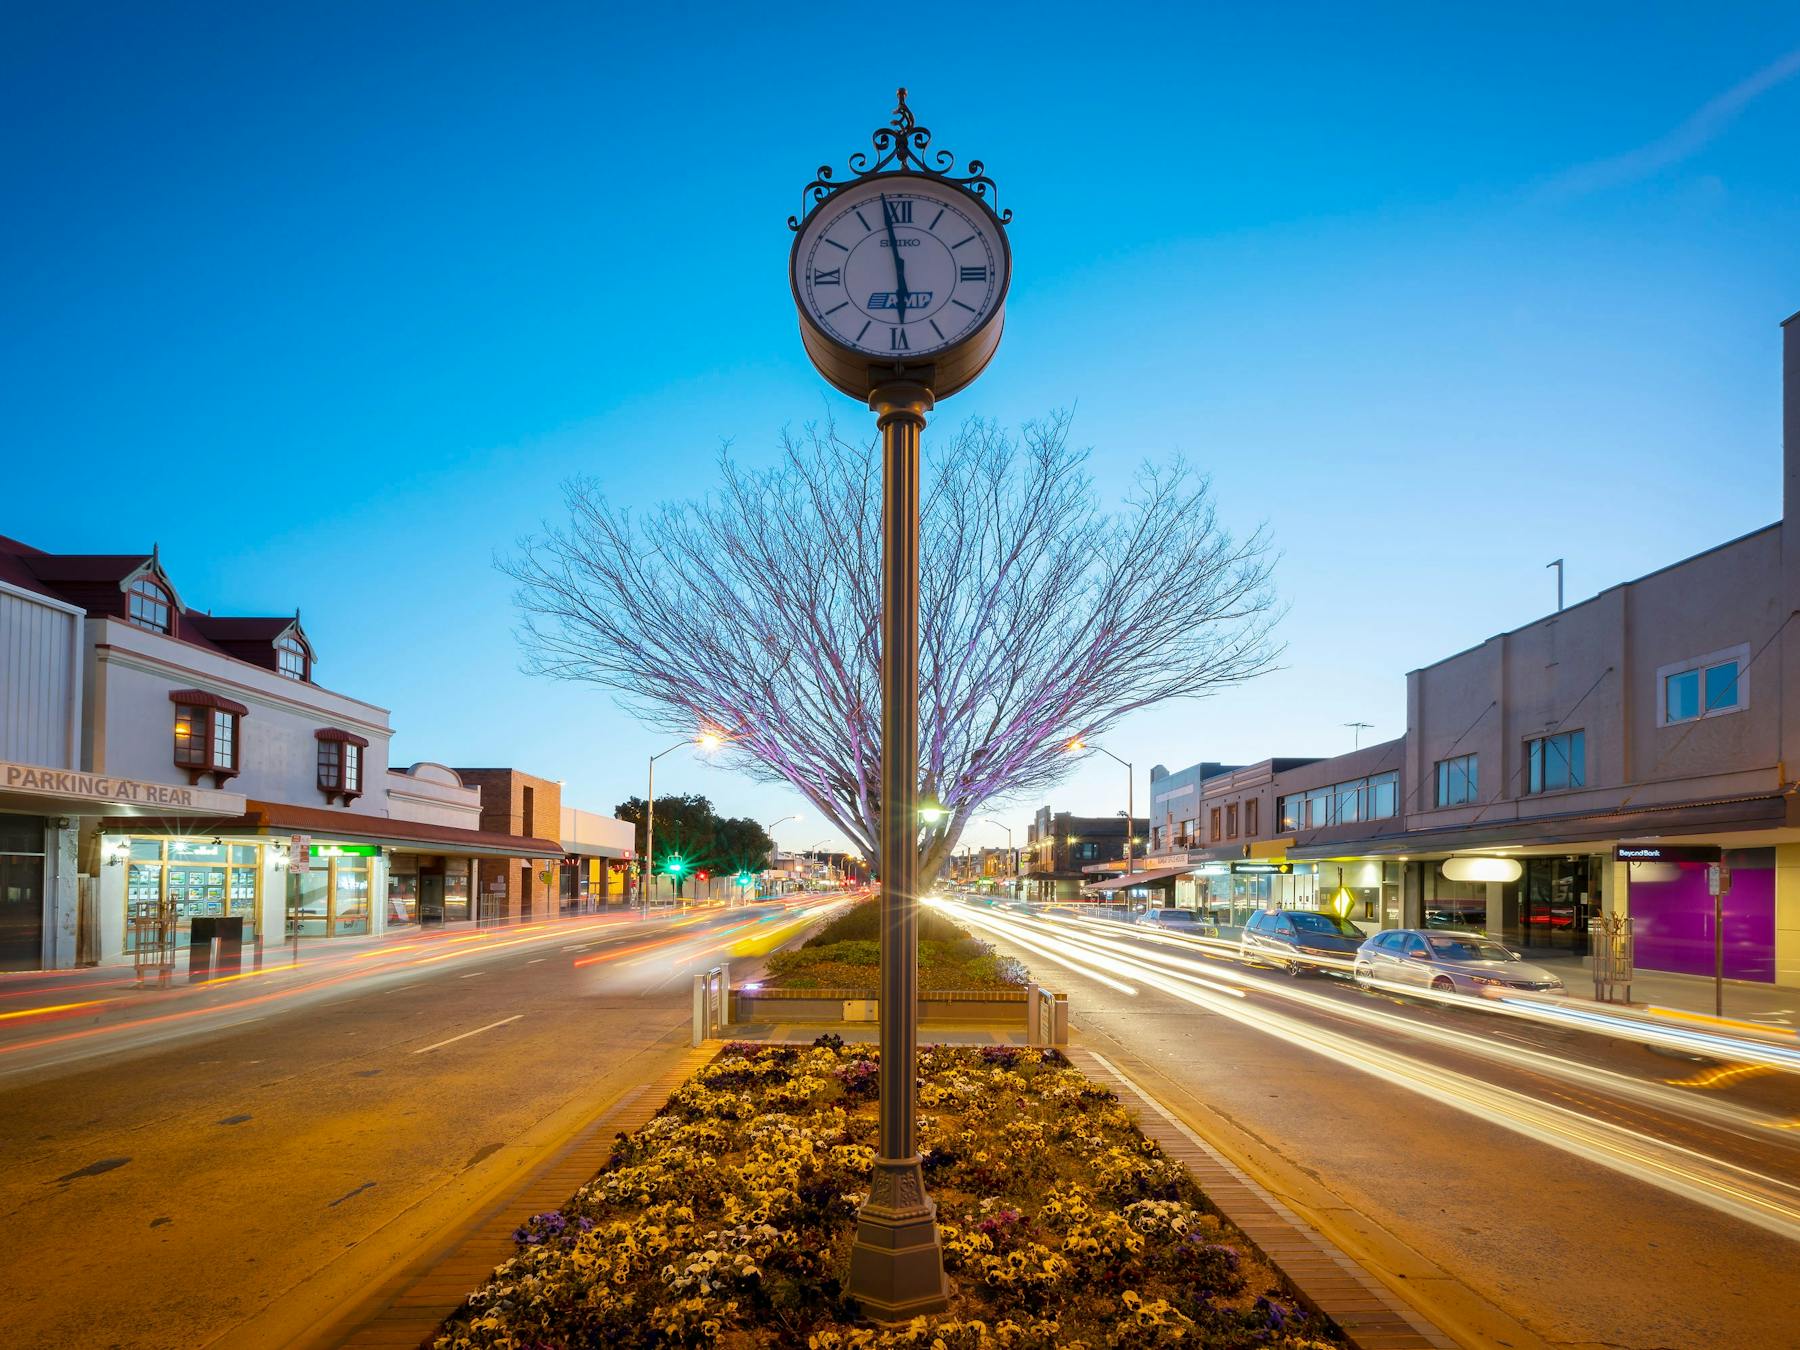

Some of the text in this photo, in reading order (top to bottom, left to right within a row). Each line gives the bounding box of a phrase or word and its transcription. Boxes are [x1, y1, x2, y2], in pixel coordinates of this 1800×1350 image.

[886, 200, 914, 223] XII
[879, 238, 921, 247] SIKO
[7, 766, 192, 806] PARKING AT REAR
